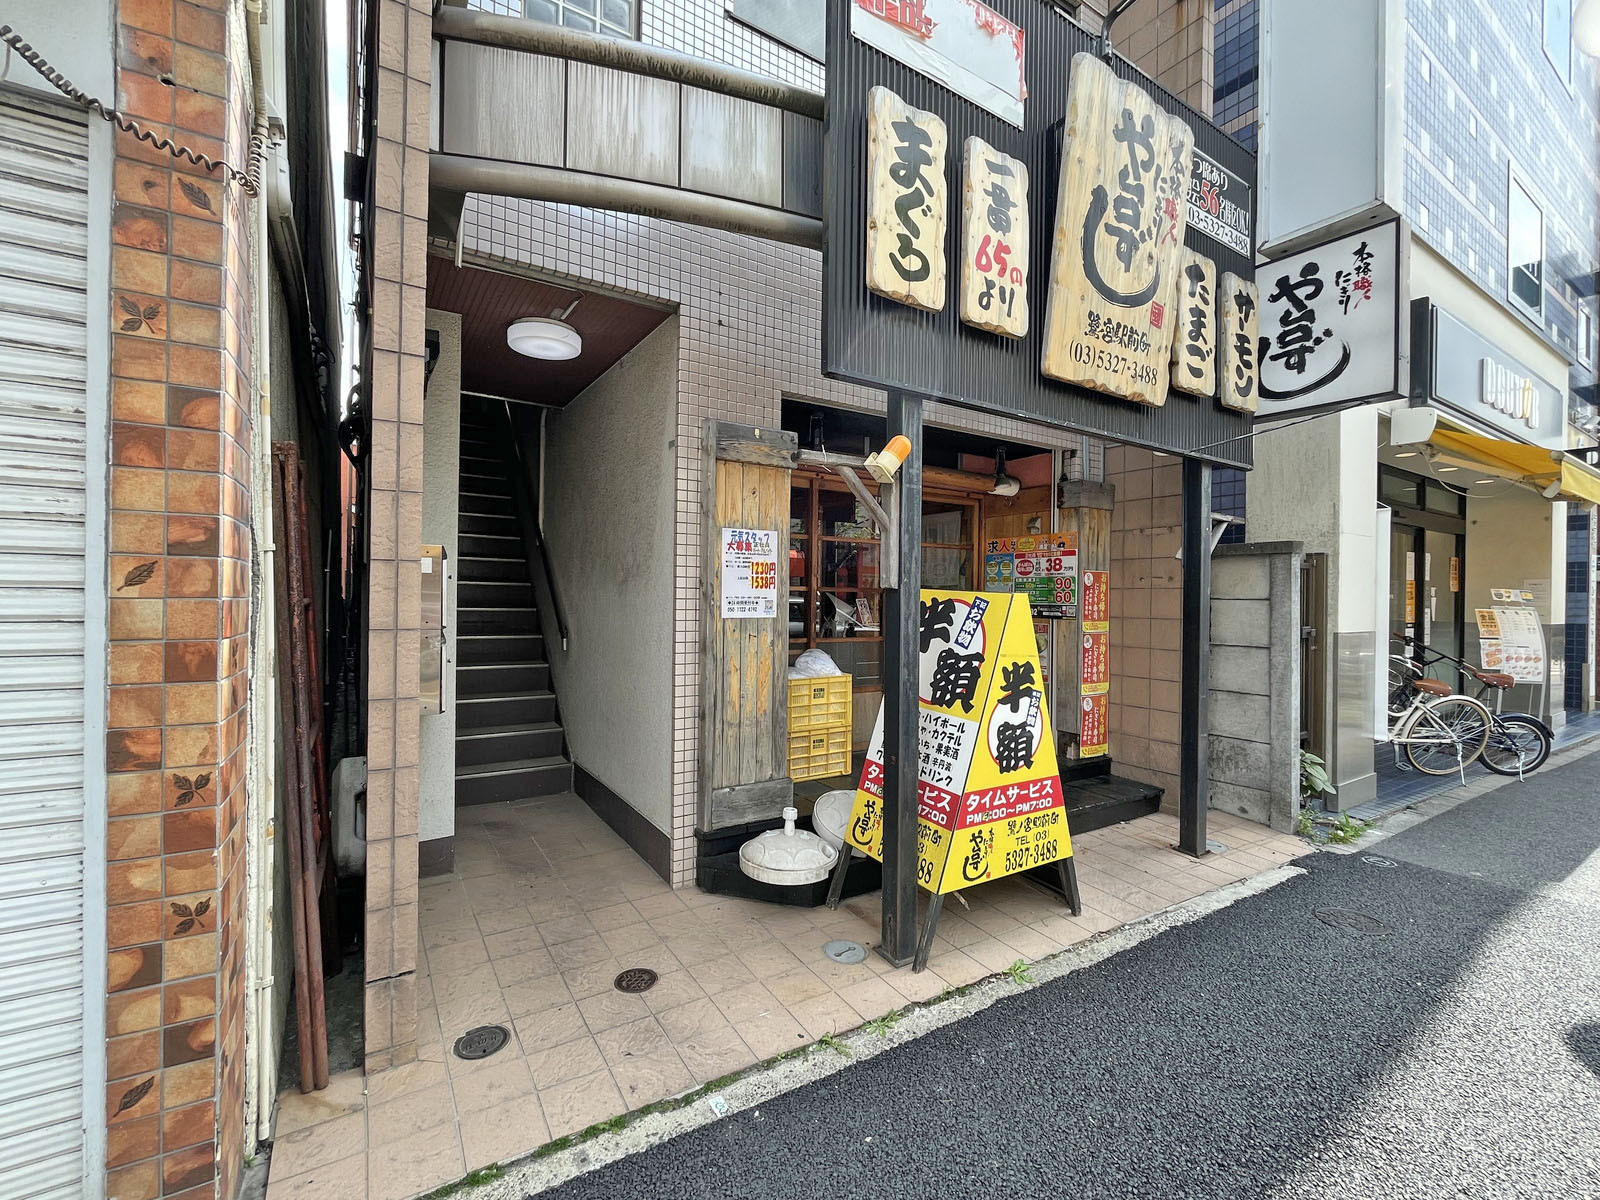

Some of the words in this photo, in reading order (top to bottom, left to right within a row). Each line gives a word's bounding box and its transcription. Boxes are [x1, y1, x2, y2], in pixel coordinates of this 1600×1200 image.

[889, 116, 935, 282] まぐろ
[1188, 206, 1249, 254] 03-5327-3488
[1352, 241, 1375, 309] 本格職人
[978, 276, 1015, 318] より
[1335, 270, 1352, 315] にぎり
[1185, 264, 1212, 379] たまご
[1233, 289, 1255, 398] サーモン
[1069, 338, 1158, 387] (03)5327-3488
[727, 541, 753, 552] 大募集
[730, 530, 770, 543] 元気スタッフ
[987, 541, 1010, 553] 求人
[751, 562, 776, 576] 1230円
[1045, 557, 1063, 573] 38
[751, 576, 776, 589] 1538円
[1055, 577, 1072, 590] 90
[1055, 591, 1072, 604] 60
[919, 712, 966, 734] ・ハイボール
[997, 661, 1036, 775] 半額
[966, 780, 1054, 812] タイムサービス
[1015, 835, 1031, 846] TEL
[1033, 829, 1050, 842] (03)
[1005, 838, 1058, 872] 5327-3488
